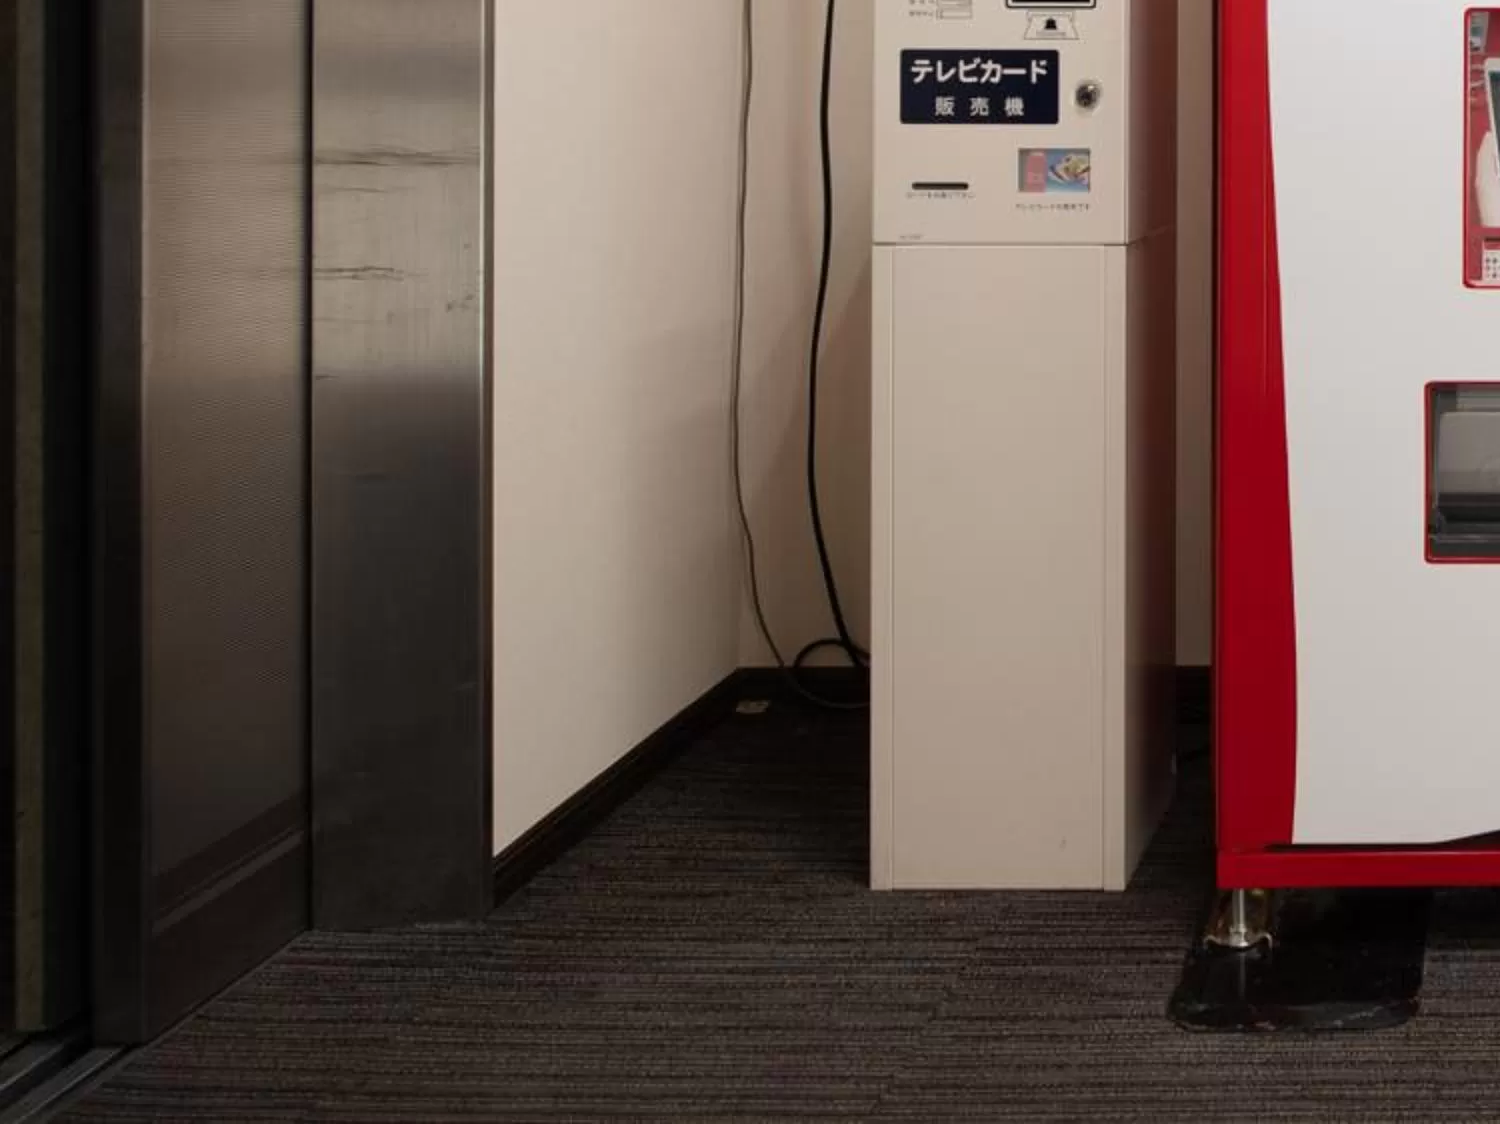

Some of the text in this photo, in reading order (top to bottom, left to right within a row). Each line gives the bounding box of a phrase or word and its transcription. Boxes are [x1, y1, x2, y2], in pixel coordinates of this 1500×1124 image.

[911, 58, 1048, 84] テレビカード
[935, 97, 1025, 117] 販売機
